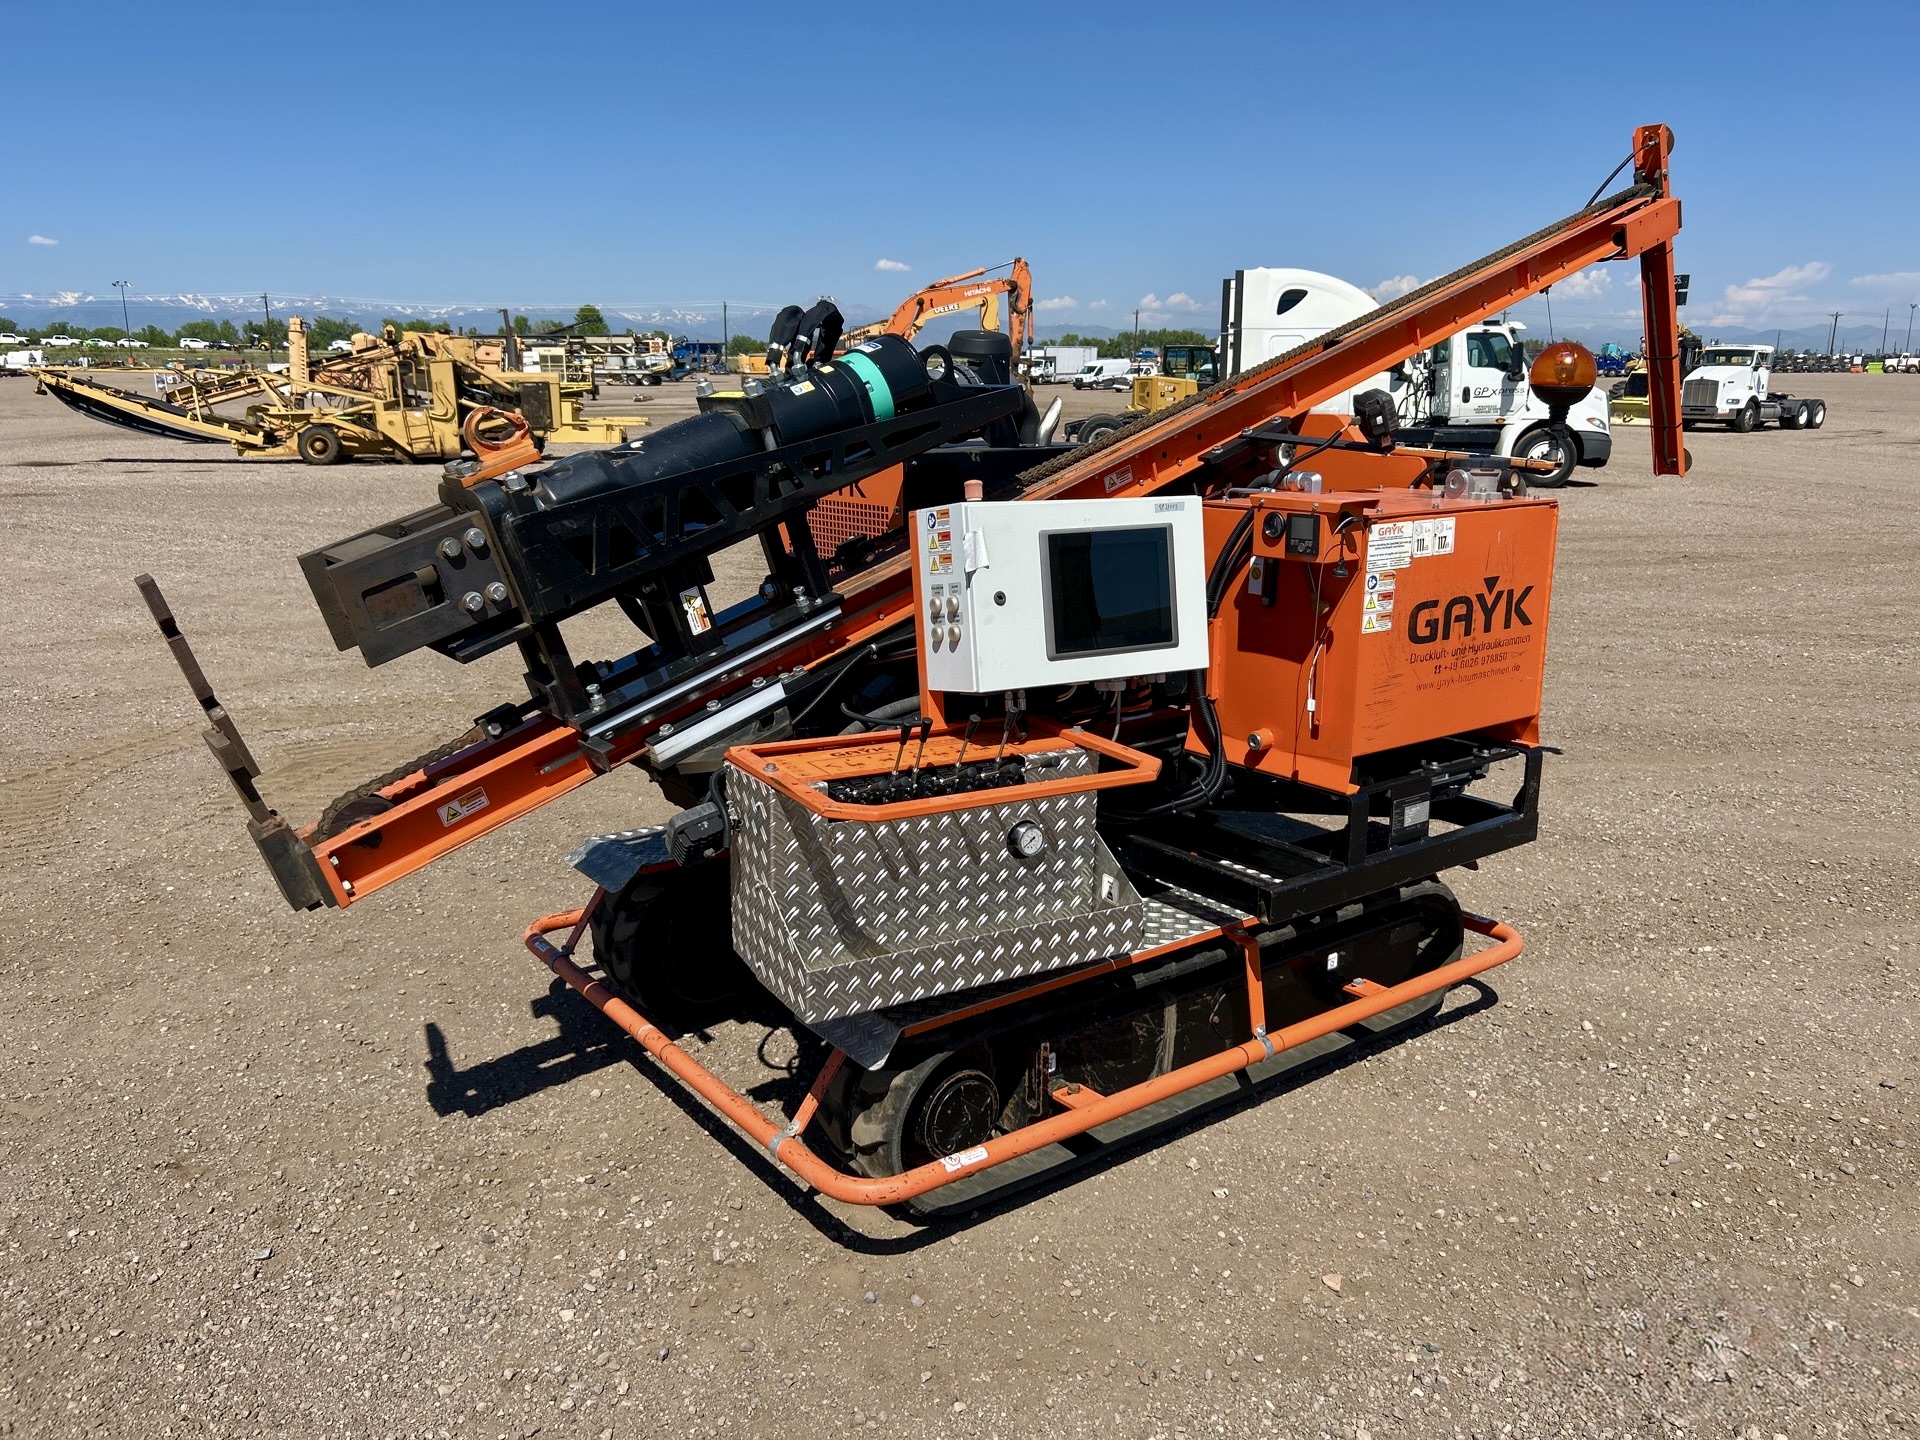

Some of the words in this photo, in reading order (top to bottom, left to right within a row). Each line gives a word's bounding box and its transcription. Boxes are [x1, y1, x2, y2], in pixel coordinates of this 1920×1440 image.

[964, 287, 991, 297] HITACHI
[934, 304, 959, 314] DEERE
[1378, 525, 1404, 536] GAYK
[1438, 536, 1447, 549] 117
[1408, 585, 1534, 644] GAYK
[1410, 648, 1449, 664] Druckluft-
[1467, 634, 1531, 655] Hydraulikrammen
[1443, 662, 1458, 672] +49
[1460, 657, 1479, 669] 6026
[830, 747, 885, 757] GAYK
